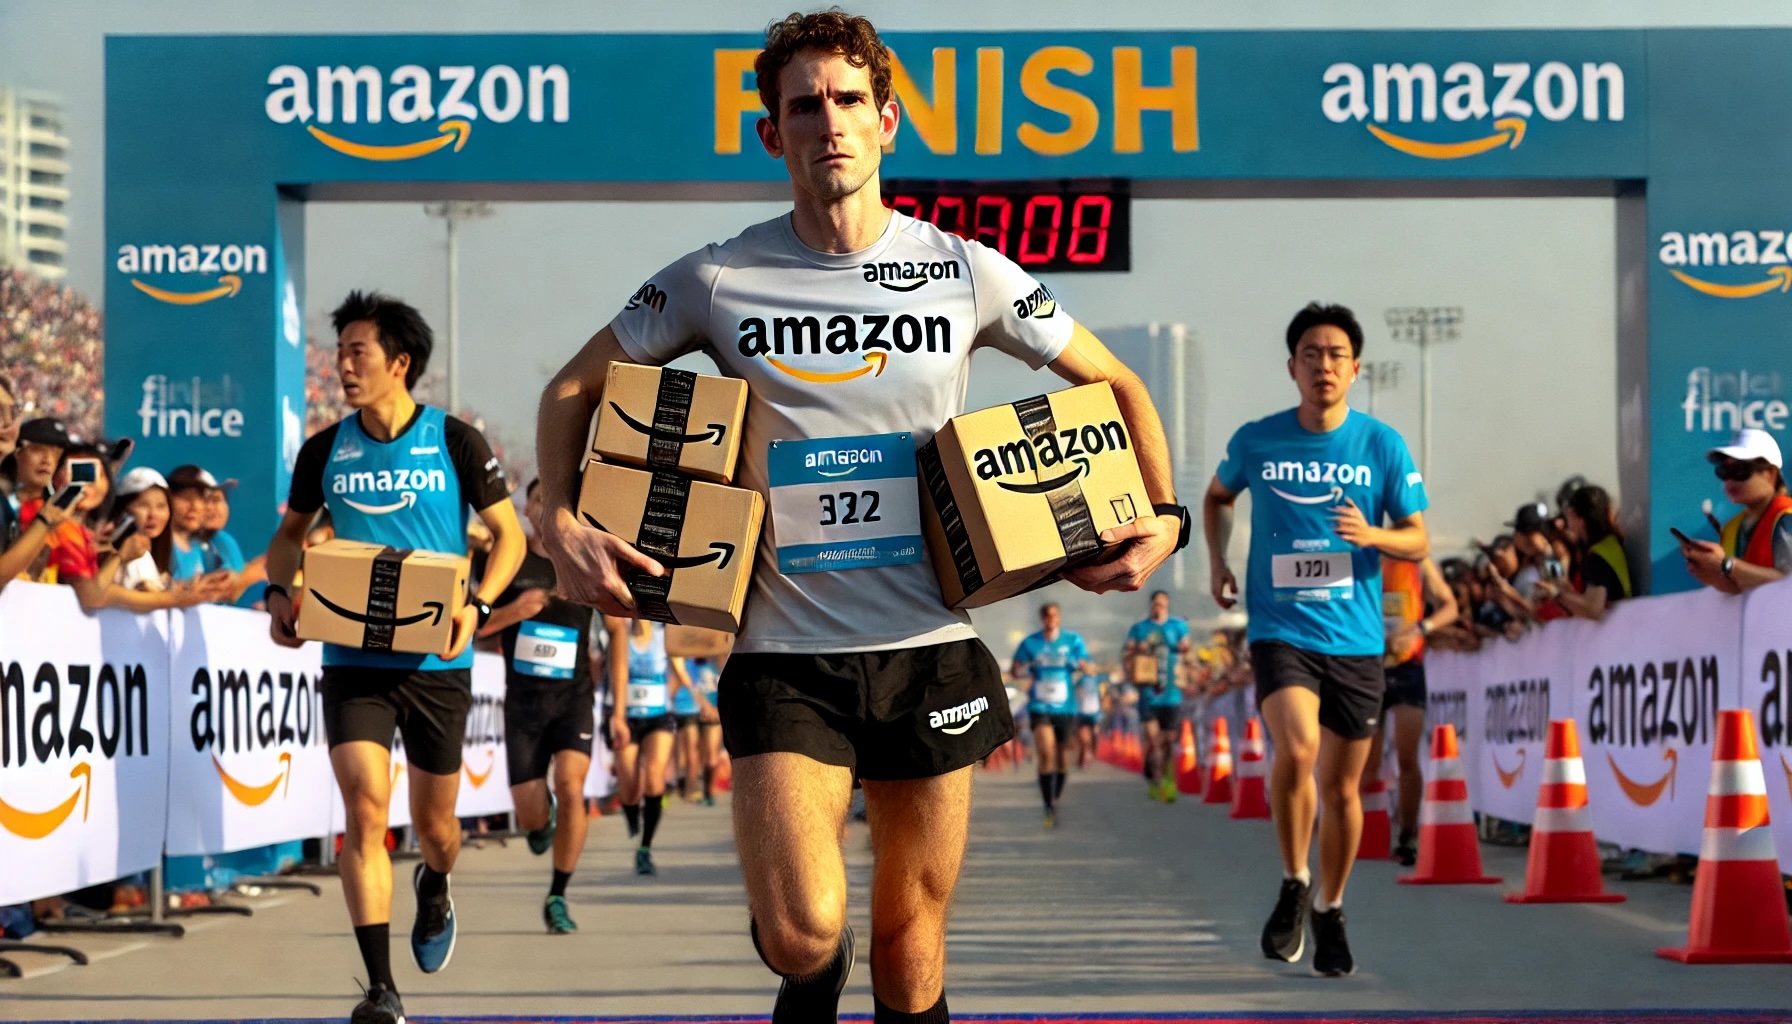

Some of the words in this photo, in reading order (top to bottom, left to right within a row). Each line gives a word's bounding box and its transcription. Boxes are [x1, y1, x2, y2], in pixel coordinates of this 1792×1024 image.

[265, 64, 570, 123] amazon
[714, 46, 1199, 155] FNISH
[1322, 61, 1624, 123] amazon
[117, 243, 268, 274] amazon
[1659, 230, 1792, 267] amaz
[862, 259, 959, 283] amazon
[738, 314, 951, 358] amazon
[974, 420, 1128, 481] amazon
[332, 468, 446, 494] amazon
[1262, 461, 1372, 487] amazon
[1589, 655, 1720, 747] amazon
